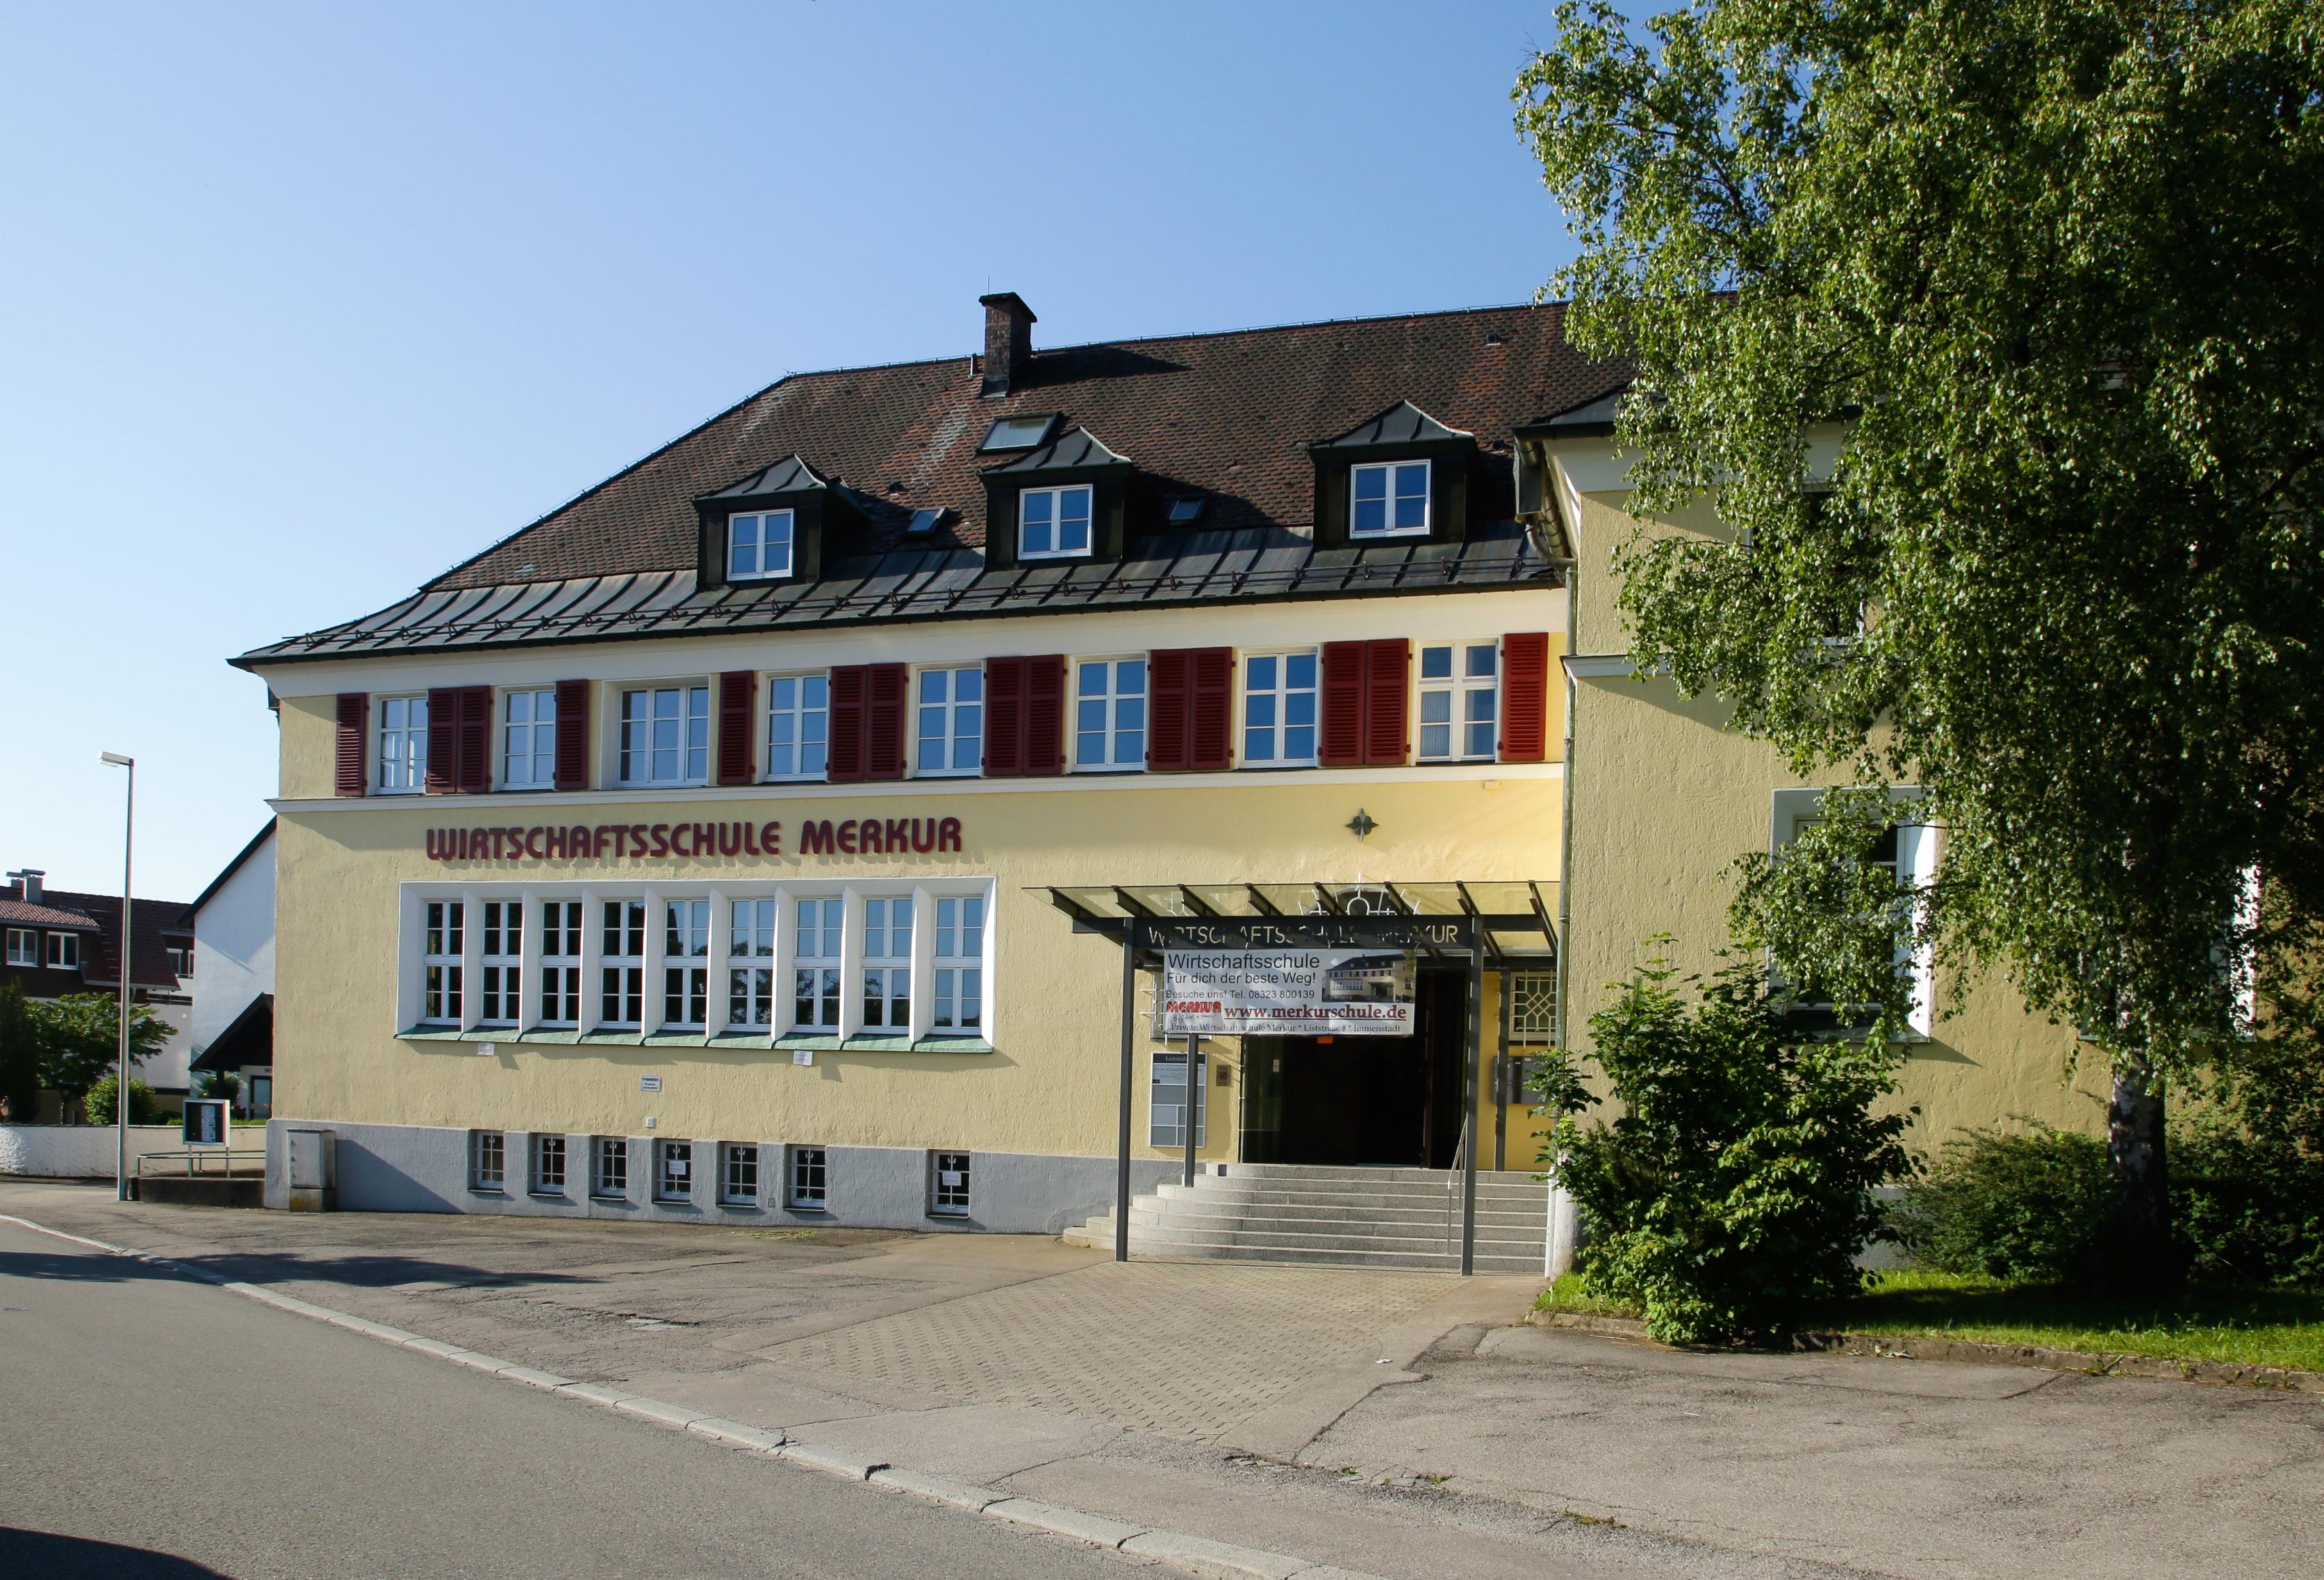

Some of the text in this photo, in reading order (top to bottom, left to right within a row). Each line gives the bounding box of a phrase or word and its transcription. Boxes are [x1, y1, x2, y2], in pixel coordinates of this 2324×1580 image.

[426, 816, 962, 861] WIRTSCHAFTSSCHULE MERKUR
[1148, 925, 1458, 944] WTSCAFTSSHLE MKUR
[1168, 953, 1320, 969] Wirtschaftsschule
[1167, 972, 1316, 987] Für dich der beste Weg!
[1166, 989, 1315, 999] Besuche uns! Tel. 08323 800139
[1166, 1001, 1223, 1014] MERKUR
[1224, 1003, 1407, 1019] www.merkurschule.de
[1171, 1024, 1198, 1032] Private
[1267, 1023, 1296, 1032] Merkur
[1303, 1023, 1340, 1032] Liststraße
[1354, 1024, 1401, 1032] Immenstadt
